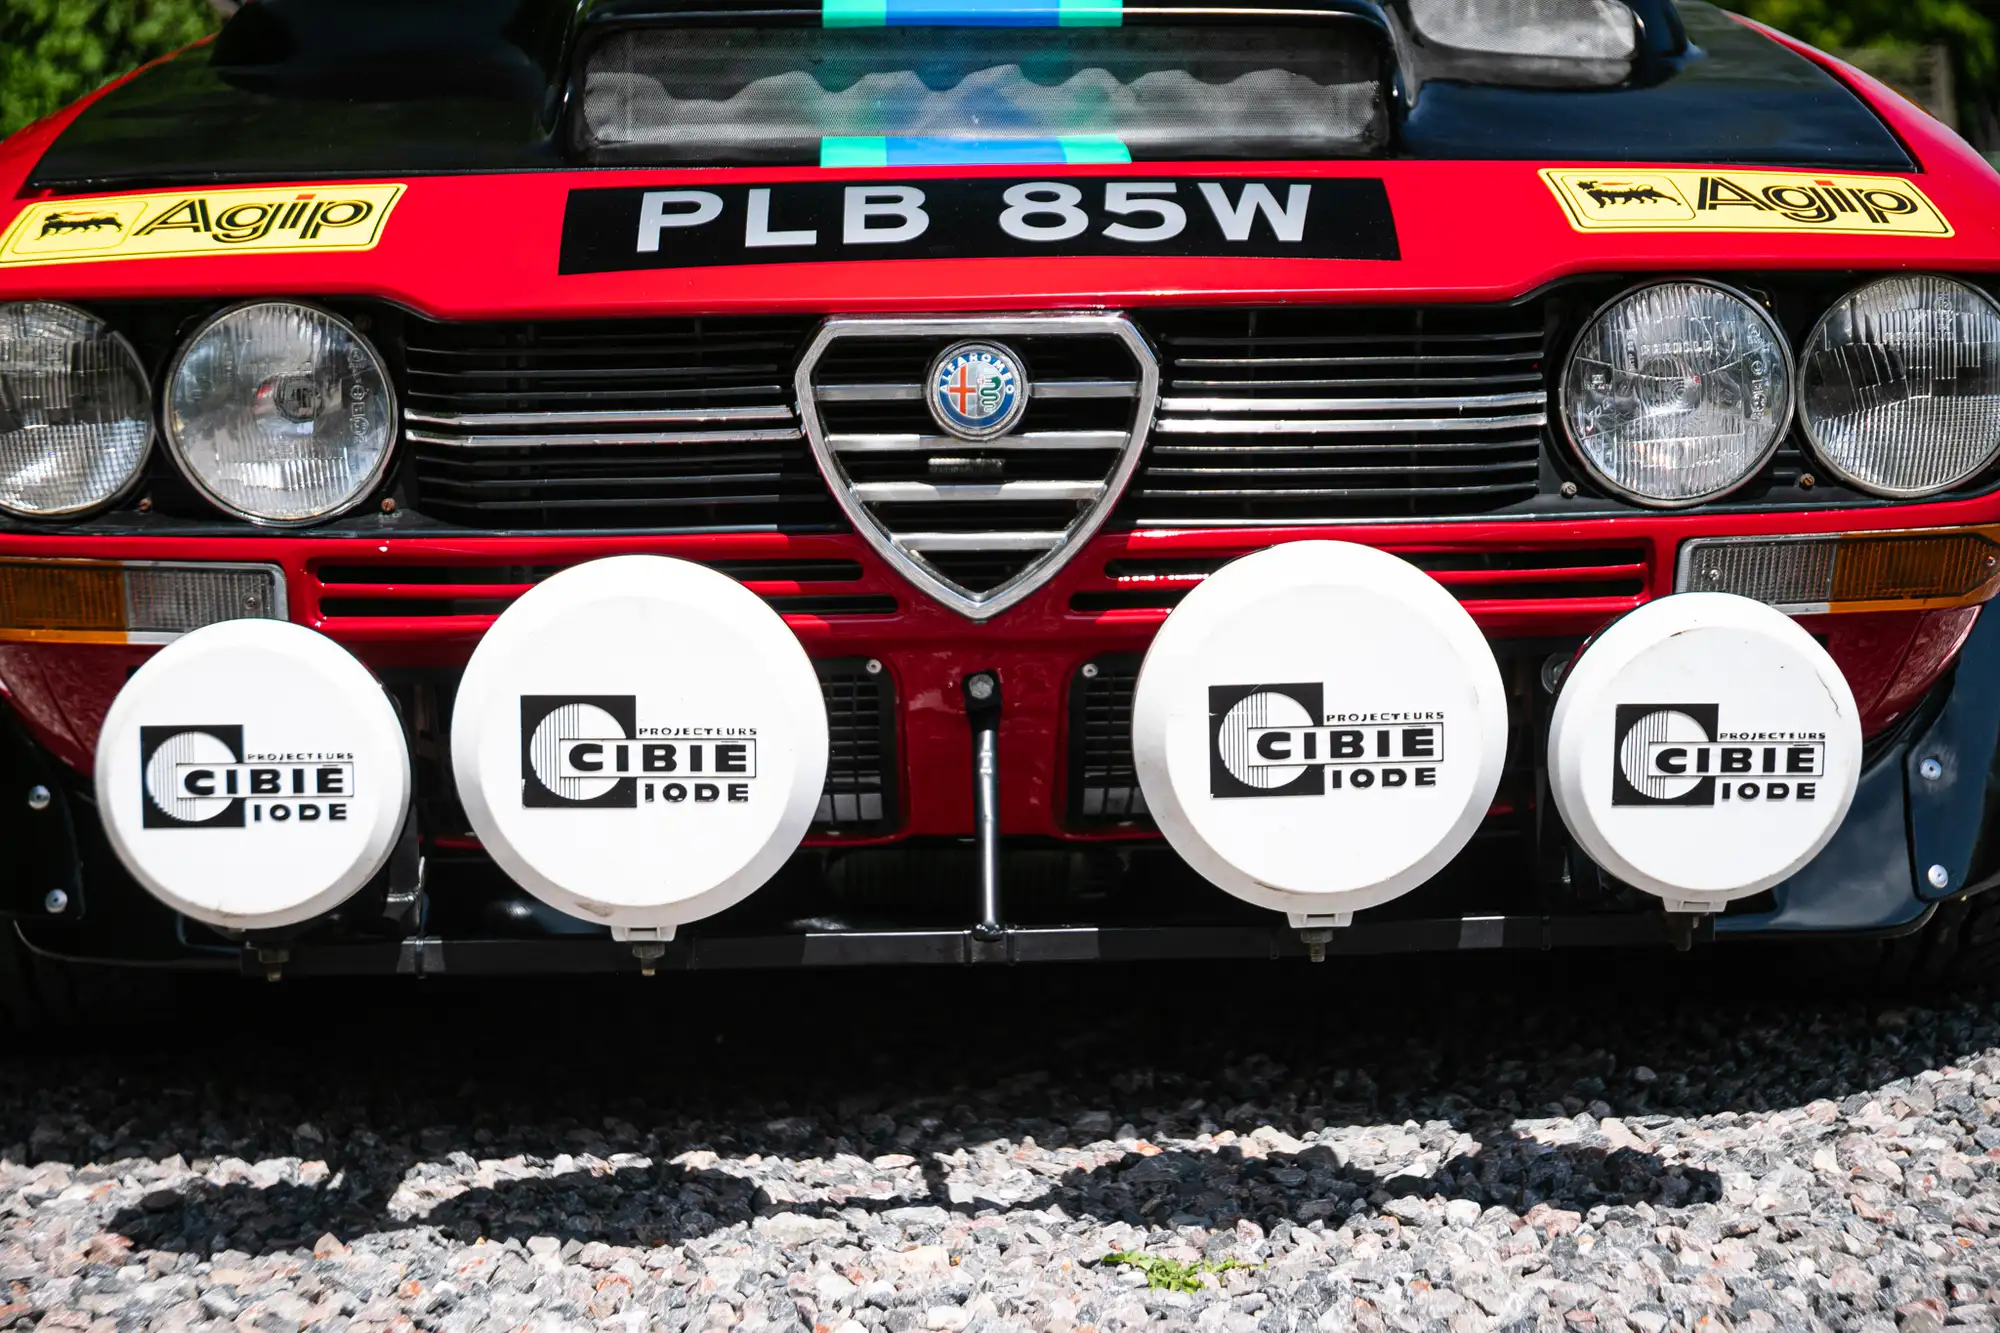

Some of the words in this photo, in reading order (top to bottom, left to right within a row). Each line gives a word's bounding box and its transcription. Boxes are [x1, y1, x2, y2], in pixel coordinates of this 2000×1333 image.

[1697, 176, 1919, 224] Agip
[132, 193, 374, 244] Agip
[636, 185, 930, 253] PLB
[999, 181, 1312, 243] 85W
[1326, 711, 1445, 723] PROJECTEURS
[638, 727, 757, 736] PROJECTEURS
[1719, 731, 1826, 740] PROJECTEURS
[247, 752, 354, 761] PROJECTEURS
[1332, 767, 1436, 789] IODE
[645, 782, 749, 803] IODE
[1721, 782, 1816, 801] IODE
[254, 803, 347, 822] IODE
